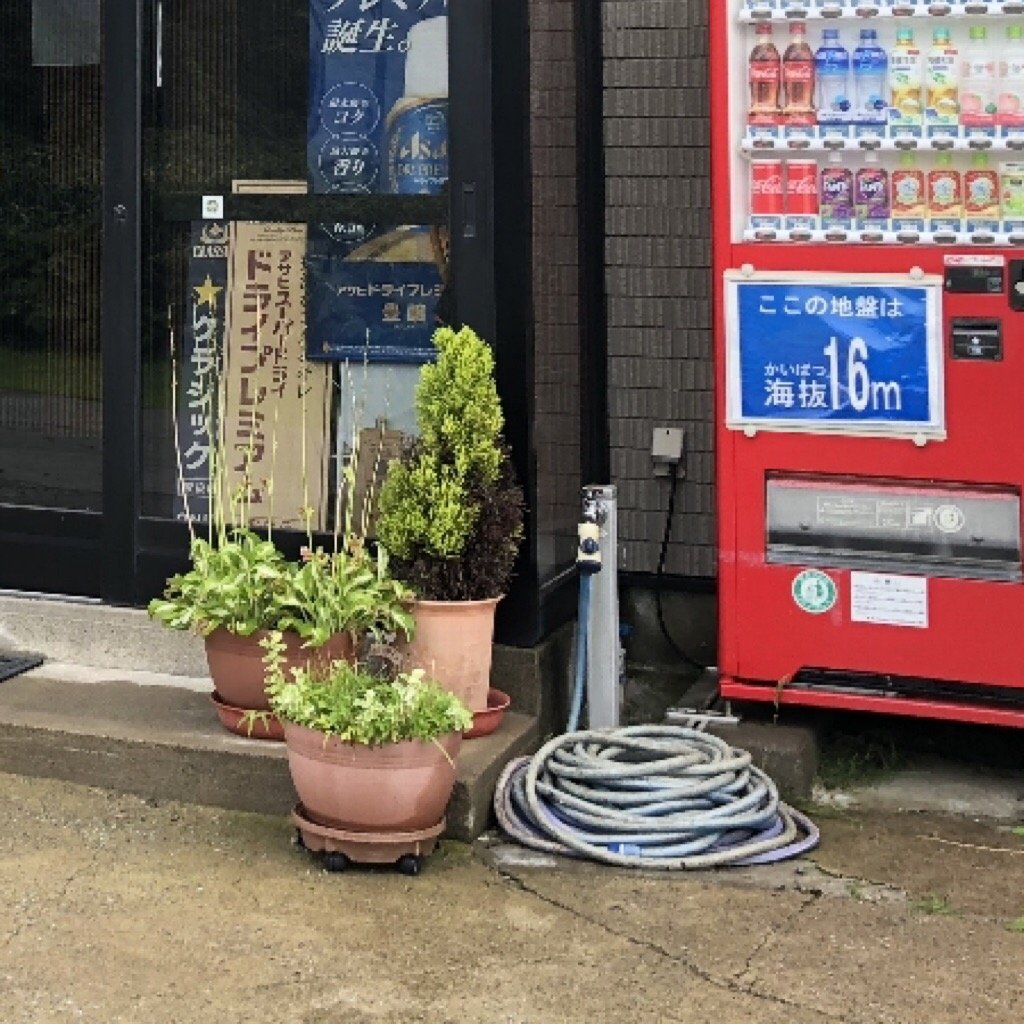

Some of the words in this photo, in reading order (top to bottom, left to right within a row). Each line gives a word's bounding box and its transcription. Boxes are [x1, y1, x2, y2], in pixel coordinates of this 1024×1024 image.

[759, 294, 905, 318] ここの地盤は
[763, 361, 826, 377] かいばつ
